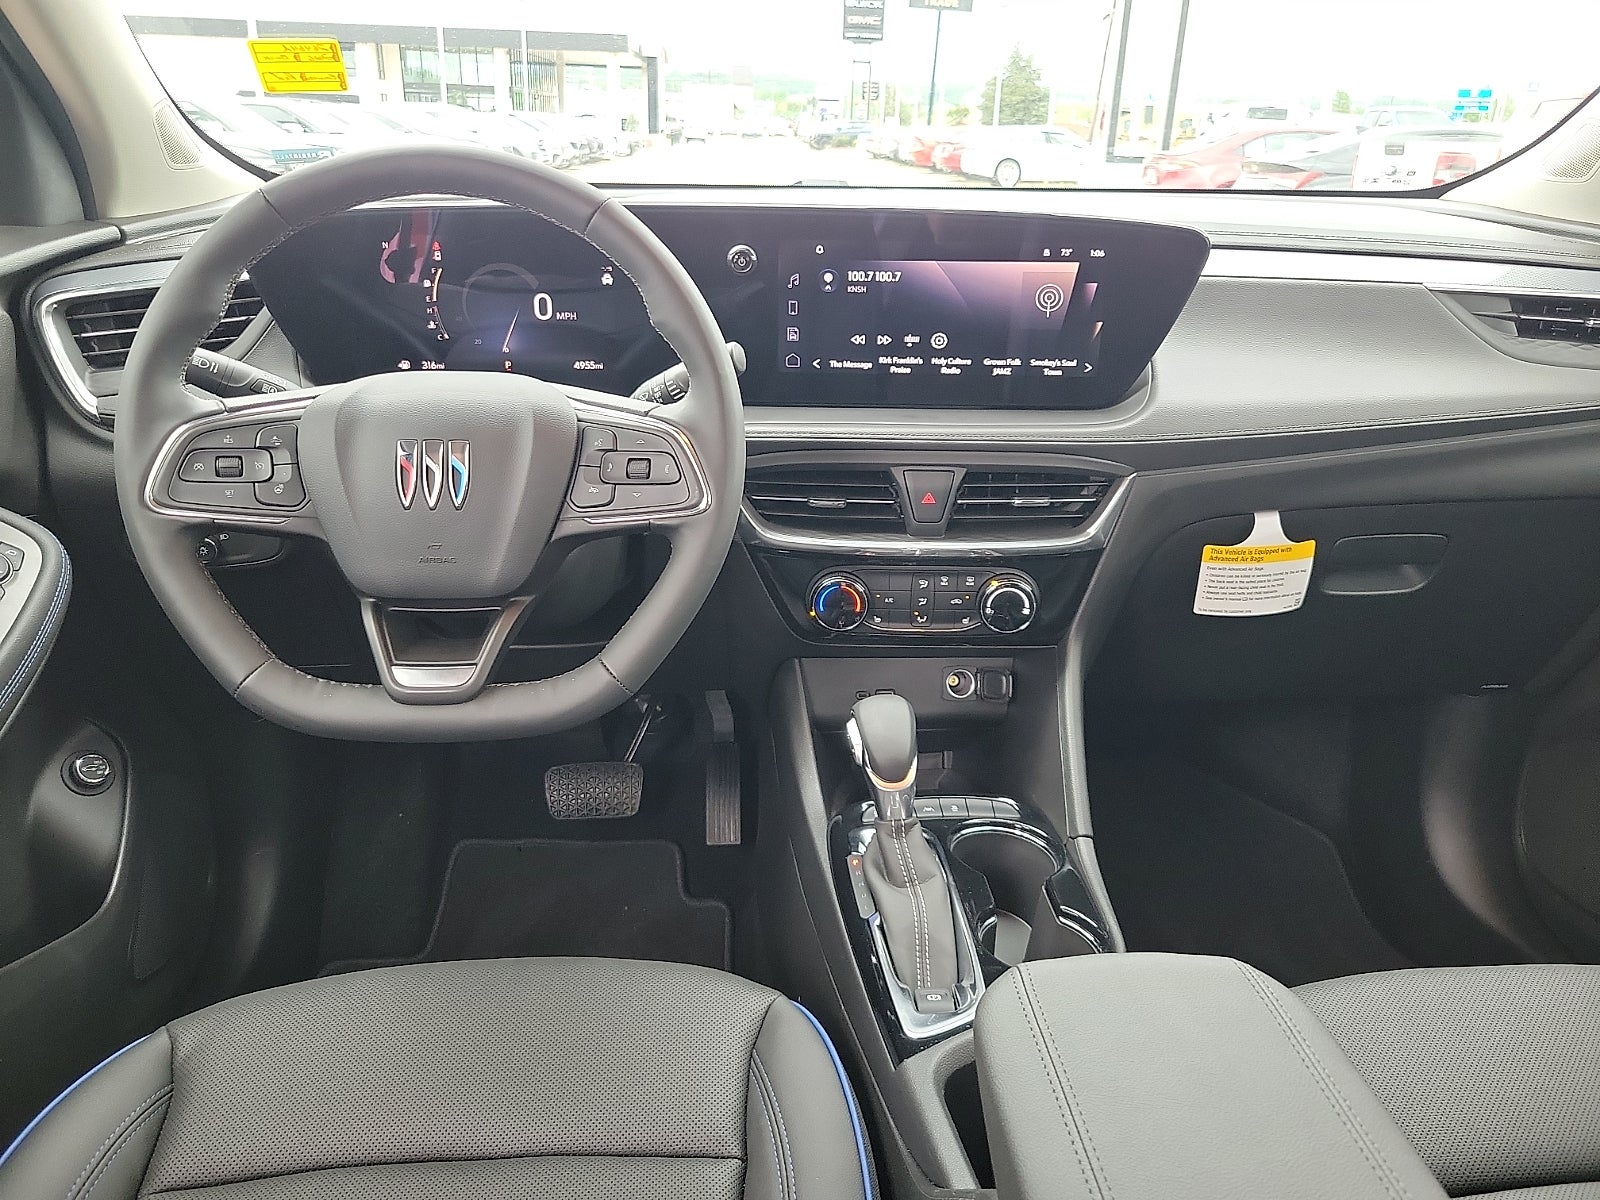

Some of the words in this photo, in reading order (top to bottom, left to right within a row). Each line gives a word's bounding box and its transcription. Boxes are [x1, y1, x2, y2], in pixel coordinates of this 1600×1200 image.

[847, 15, 882, 25] GMC
[1090, 249, 1105, 257] 1:06
[847, 270, 872, 282] 100.7
[875, 271, 902, 282] 100.7
[533, 292, 553, 321] 0
[556, 312, 578, 320] MPH
[573, 362, 604, 370] 4955mi
[829, 360, 842, 368] The
[843, 360, 873, 370] Message
[931, 358, 947, 366] Holy
[1030, 359, 1061, 368] Smokey's
